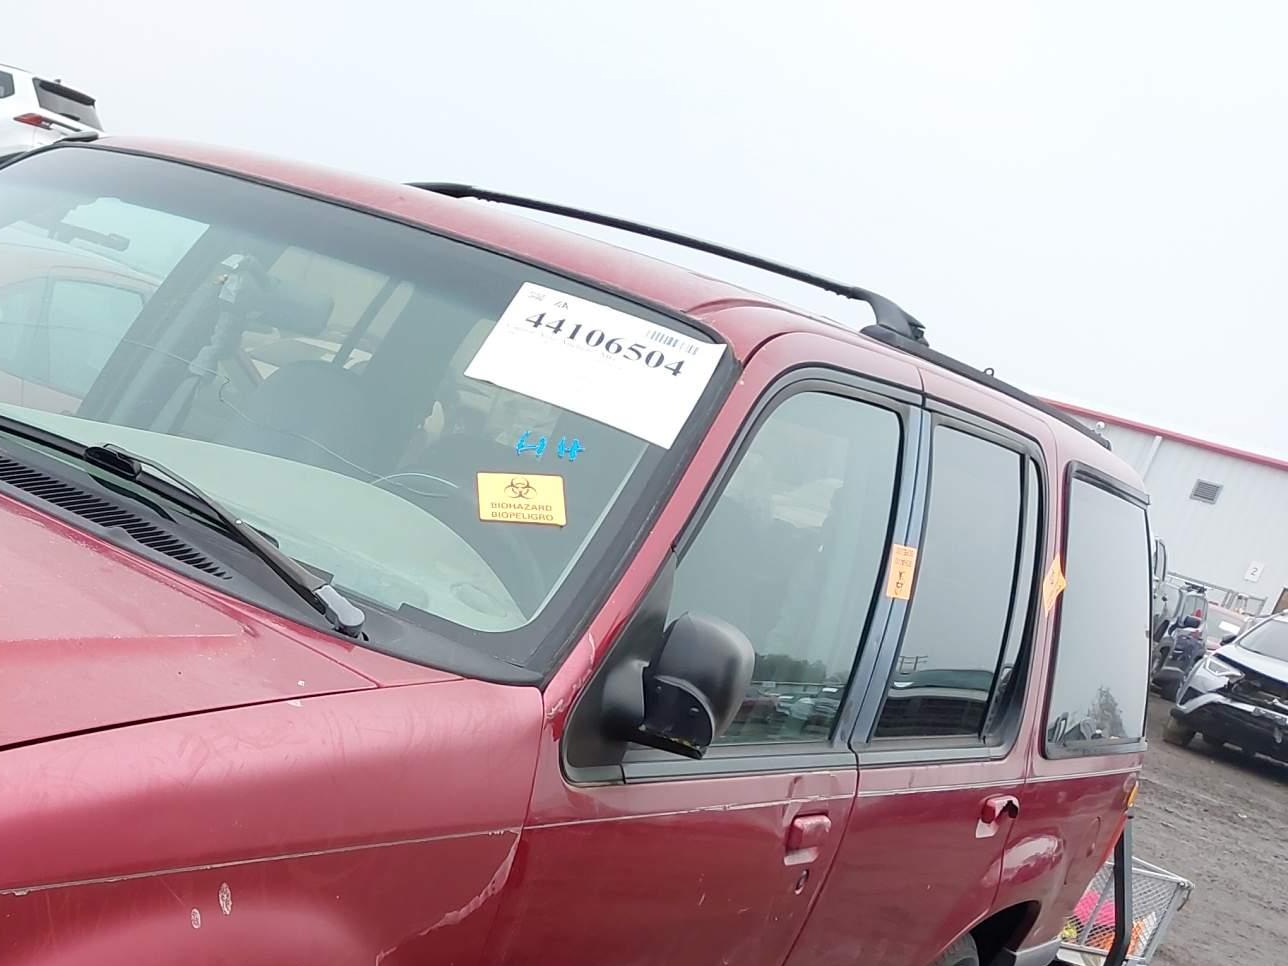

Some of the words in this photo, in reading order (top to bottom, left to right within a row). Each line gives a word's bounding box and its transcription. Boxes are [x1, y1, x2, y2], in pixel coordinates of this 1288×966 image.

[524, 312, 686, 376] 44106504
[490, 502, 553, 512] BIOHAZARD
[491, 511, 554, 521] BIOPELIGRO
[1250, 567, 1258, 577] 2
